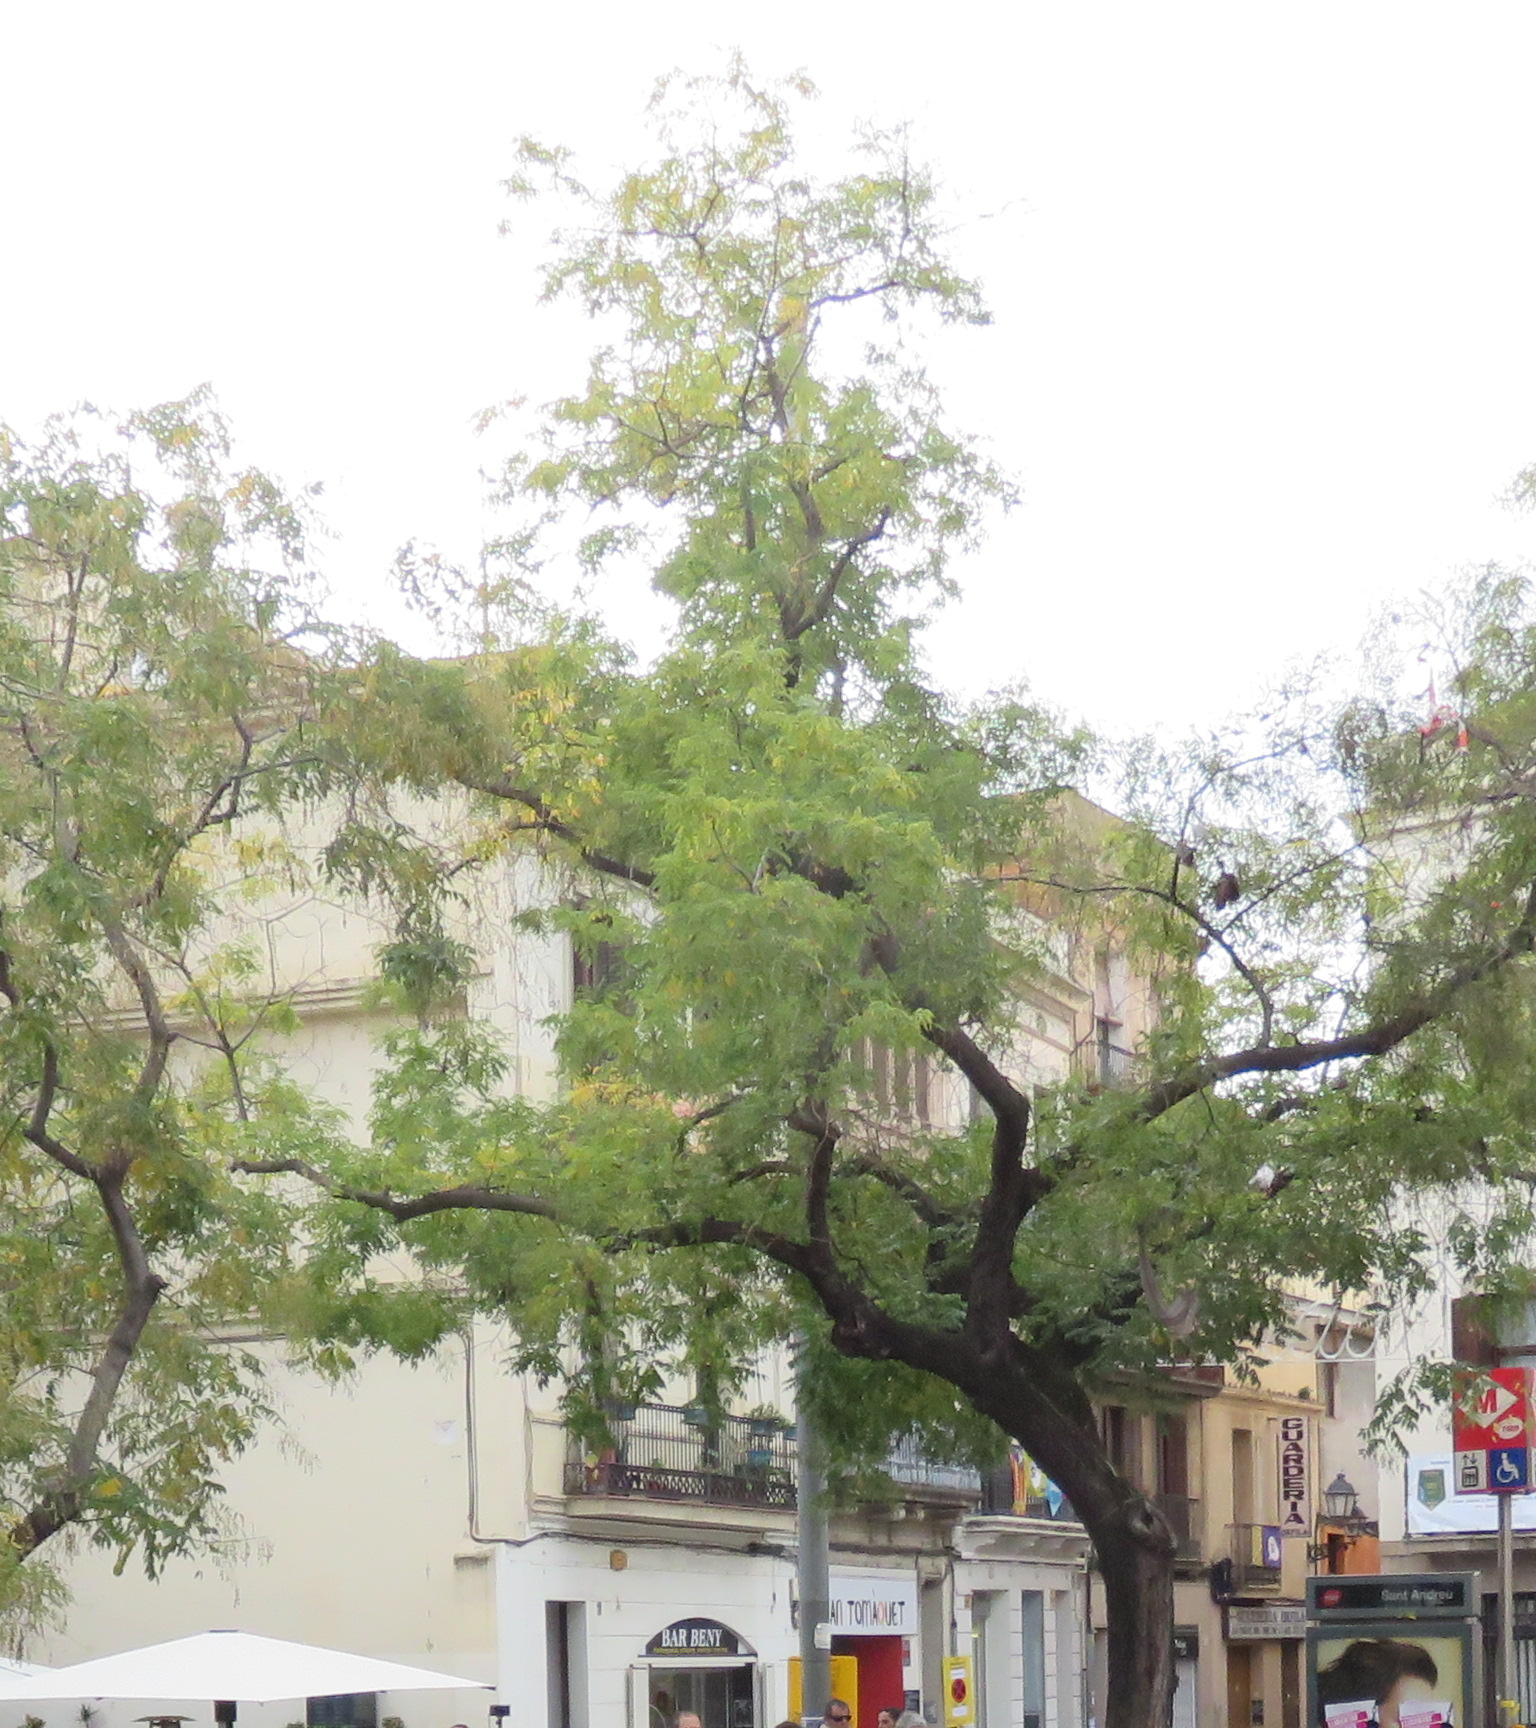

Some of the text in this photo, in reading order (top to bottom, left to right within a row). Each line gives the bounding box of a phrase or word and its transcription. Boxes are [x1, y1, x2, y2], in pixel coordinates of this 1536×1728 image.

[1282, 1418, 1305, 1525] GUARDERIA
[1381, 1588, 1453, 1601] Sant Andreu
[662, 1629, 723, 1648] BAR BENY
